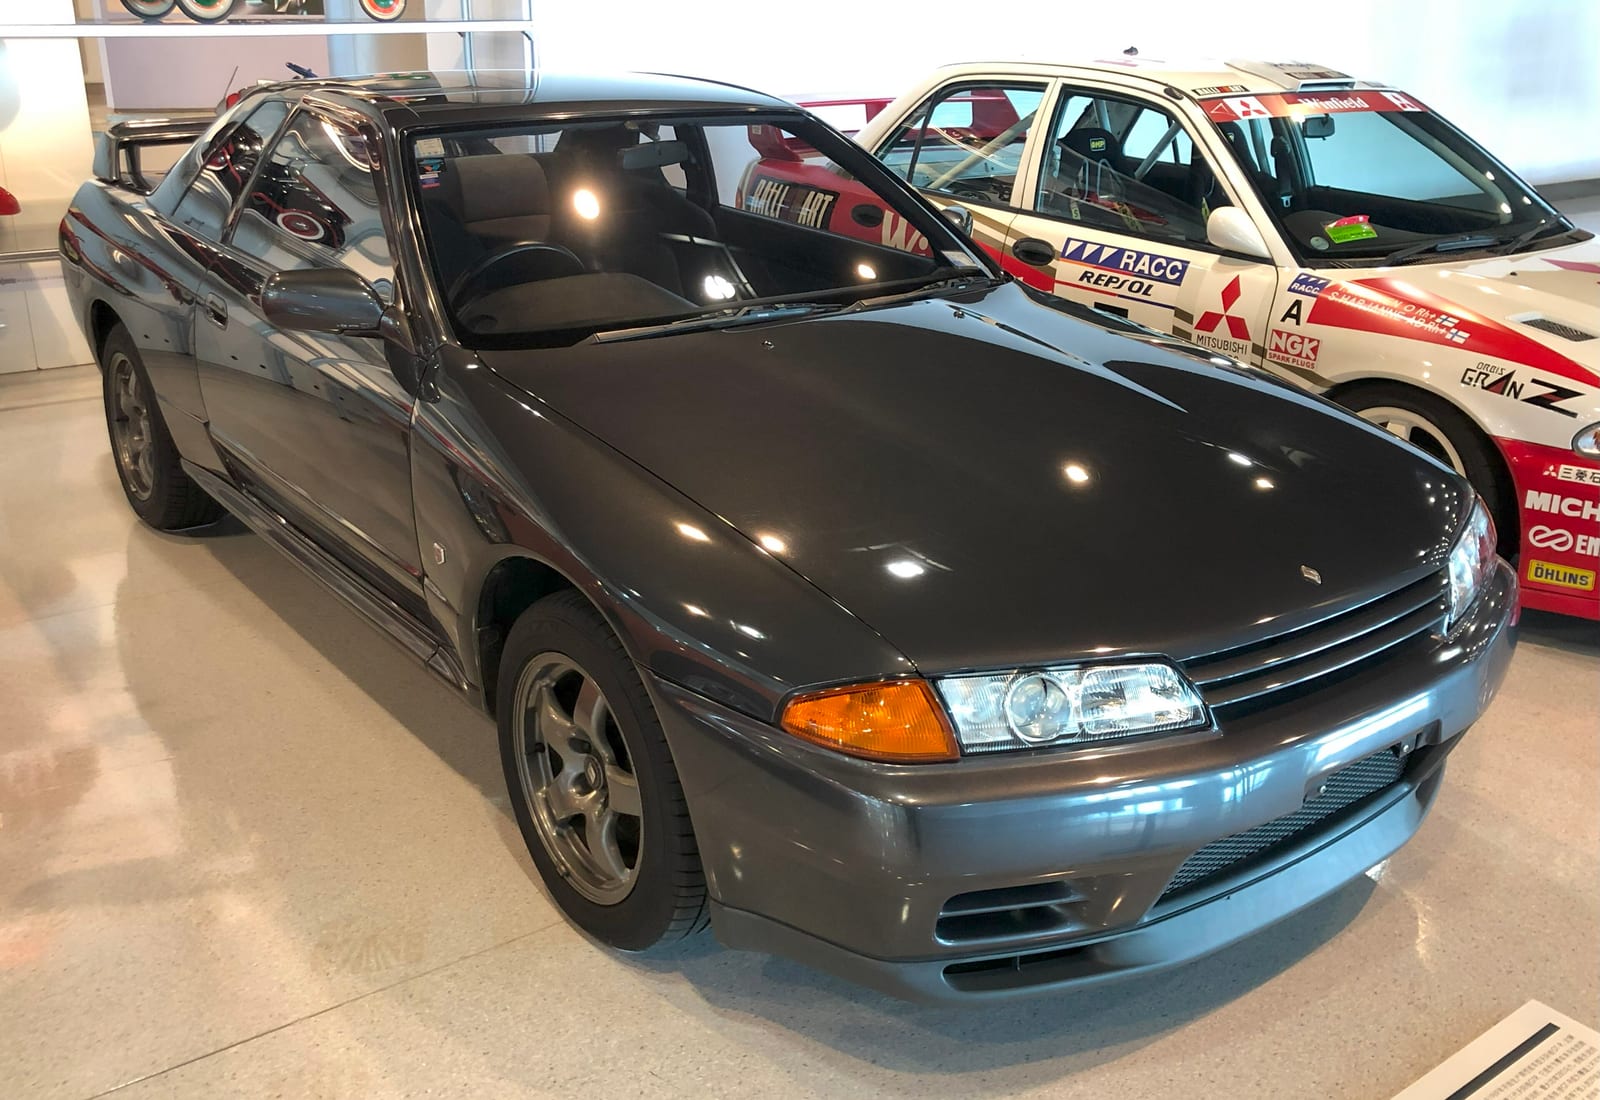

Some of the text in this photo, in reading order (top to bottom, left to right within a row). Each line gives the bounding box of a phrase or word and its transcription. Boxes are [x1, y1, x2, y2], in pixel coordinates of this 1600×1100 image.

[798, 191, 834, 229] ART
[1119, 250, 1183, 280] RACC
[1078, 270, 1154, 297] REPSOL
[1291, 282, 1320, 295] RACC
[1280, 299, 1303, 326] A
[1196, 333, 1248, 356] MITSUBISHI
[1270, 330, 1319, 361] NGK
[1268, 352, 1316, 370] SPARK PLUGS
[1476, 361, 1506, 376] ORBIS
[1534, 563, 1589, 586] ÖHLINS
